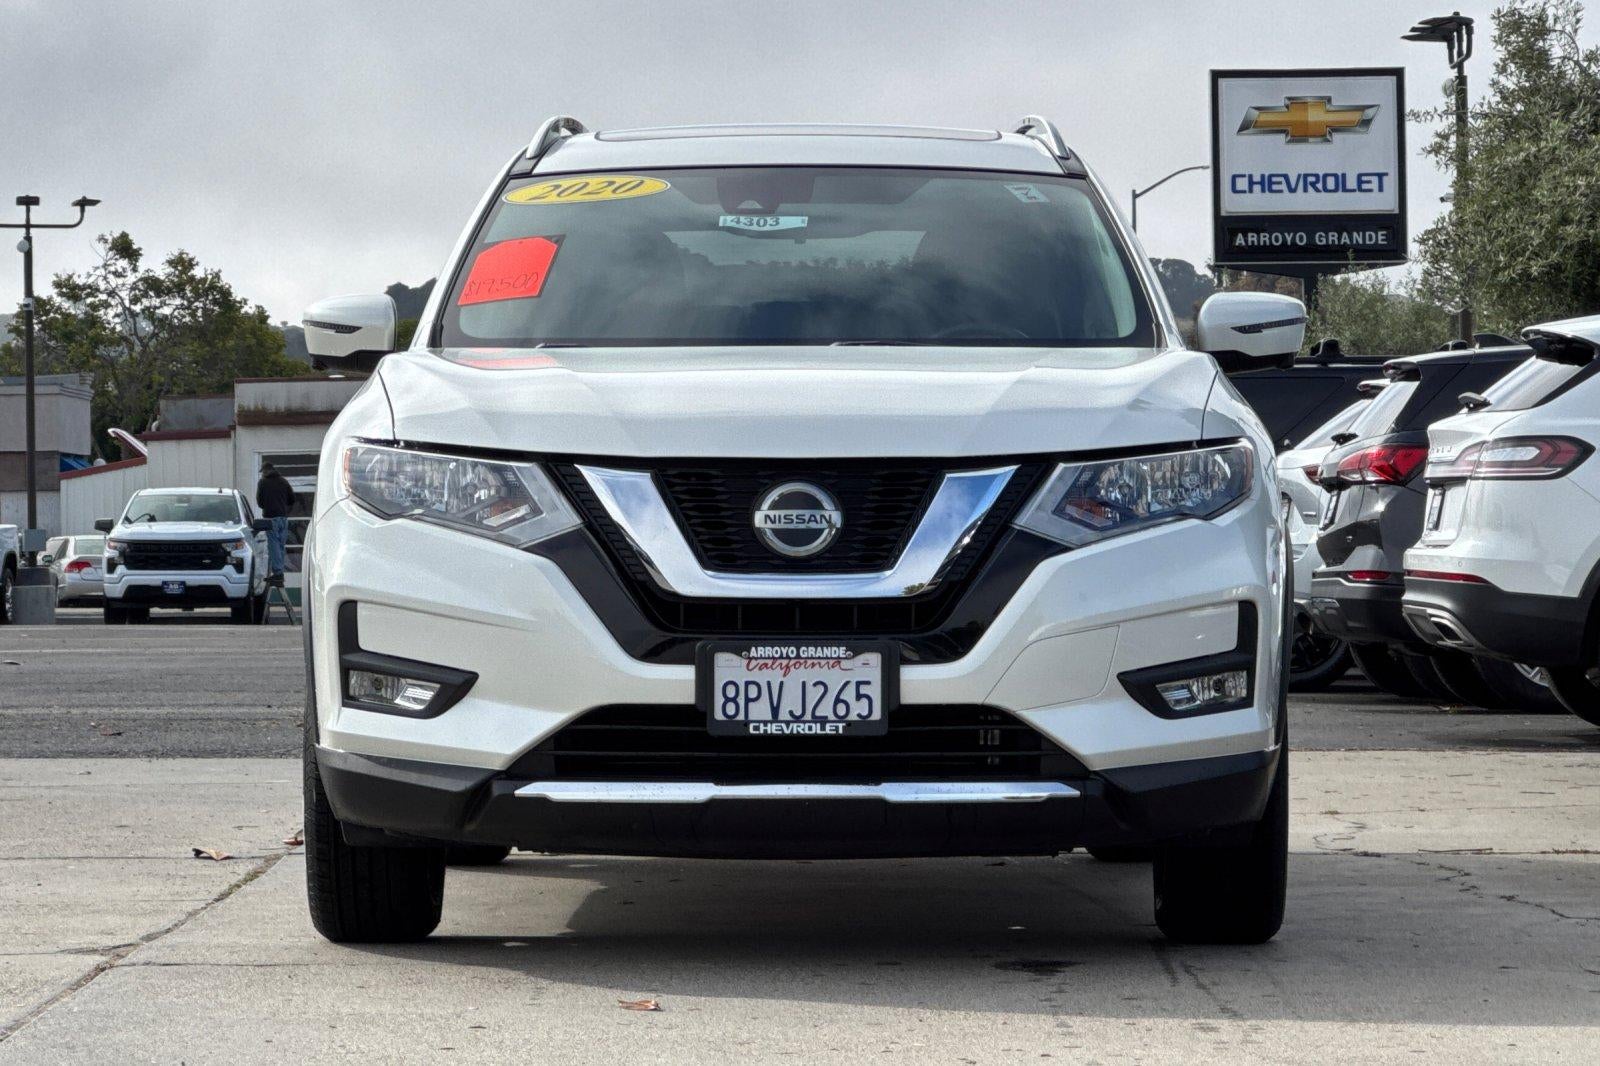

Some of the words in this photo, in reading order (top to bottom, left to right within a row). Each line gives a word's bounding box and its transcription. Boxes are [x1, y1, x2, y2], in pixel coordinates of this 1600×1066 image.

[525, 179, 645, 201] 2020
[1230, 172, 1389, 194] CHEVROLET
[730, 216, 780, 228] 4303
[1235, 232, 1307, 246] ARROYO
[1315, 231, 1388, 245] GRANDE
[764, 513, 833, 525] NISSAN
[749, 646, 797, 658] ARROYO
[799, 646, 847, 658] GRANDE
[745, 657, 854, 678] California
[720, 680, 874, 720] 8PVJ265
[749, 722, 847, 734] CHEVROLET
